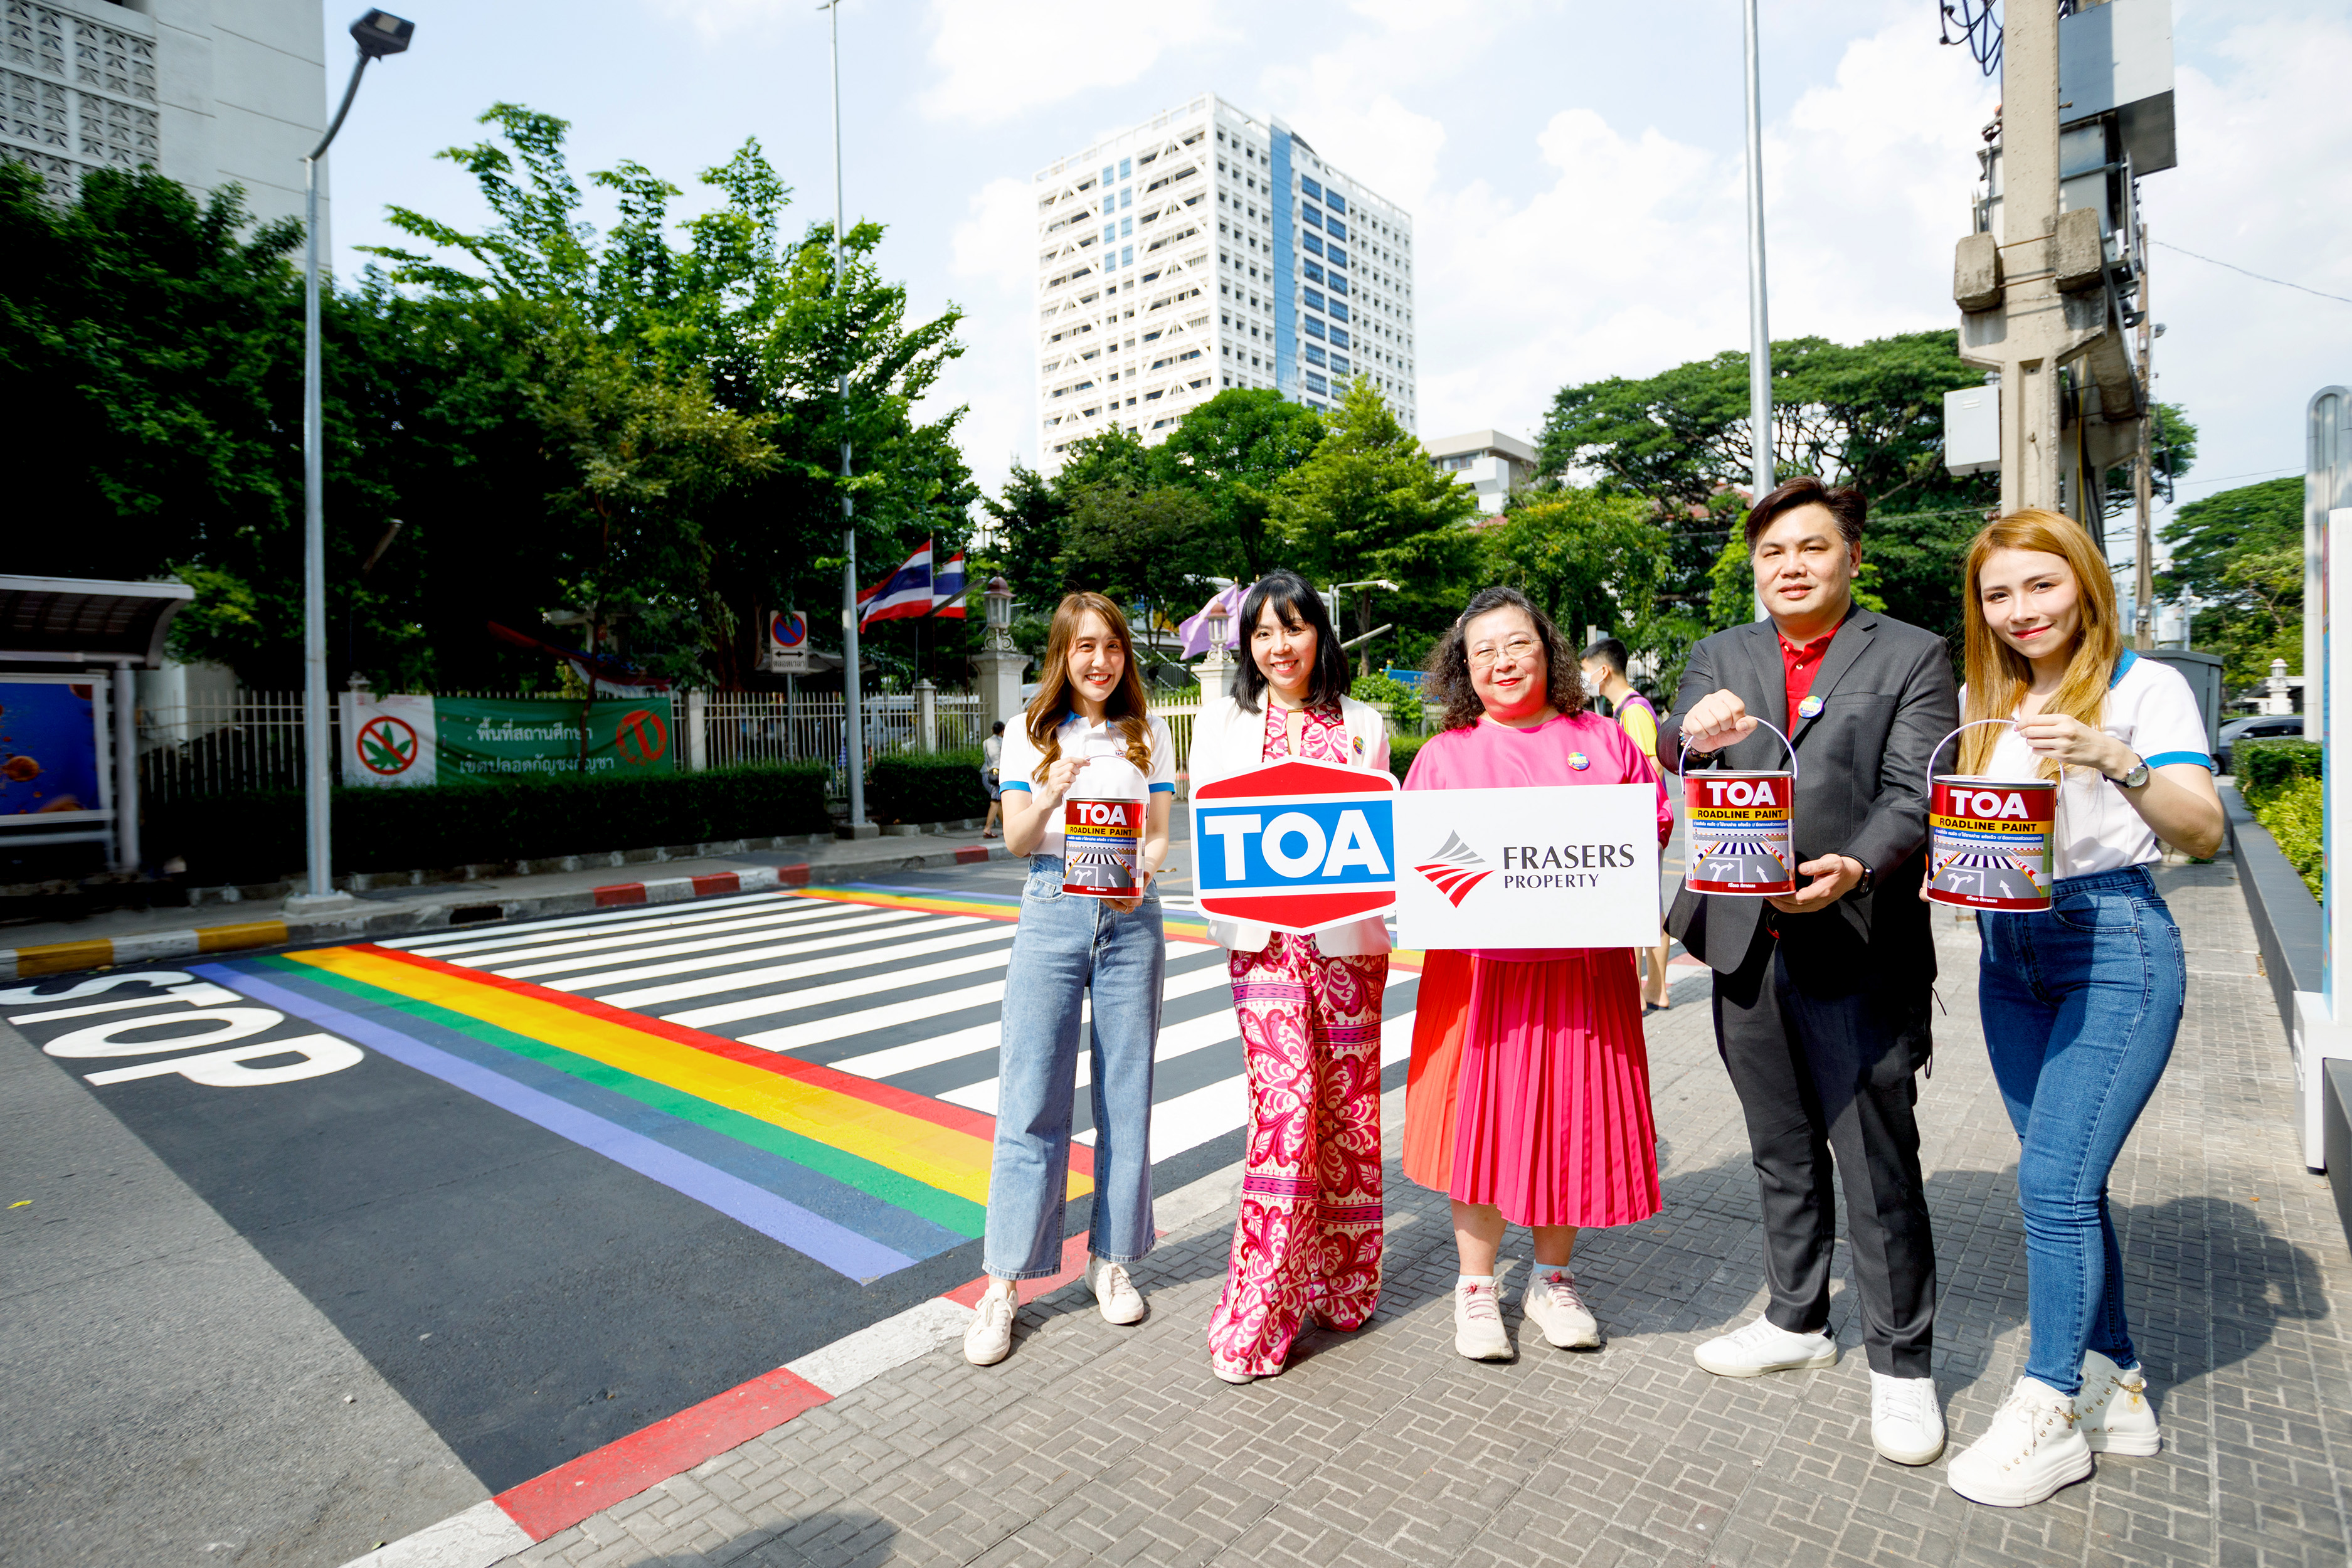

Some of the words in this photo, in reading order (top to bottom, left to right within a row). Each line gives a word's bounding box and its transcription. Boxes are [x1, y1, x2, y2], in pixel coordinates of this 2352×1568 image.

[476, 716, 593, 742] พื้นที่สถานศึกษา
[1706, 781, 1776, 807] TOA
[1950, 789, 2029, 819] TOA
[1076, 803, 1127, 825] TOA
[1697, 810, 1750, 818] ROADLINE
[1754, 810, 1783, 818] PAINT
[1939, 818, 1996, 831] ROADLINE
[2001, 823, 2037, 832] PAINT
[1069, 826, 1106, 835] ROADLINE
[1110, 828, 1133, 836] PAINT
[1204, 809, 1390, 881] TOA
[1503, 844, 1634, 870] FRASERS
[1504, 874, 1599, 889] PROPERTY
[0, 971, 364, 1088] STOP
